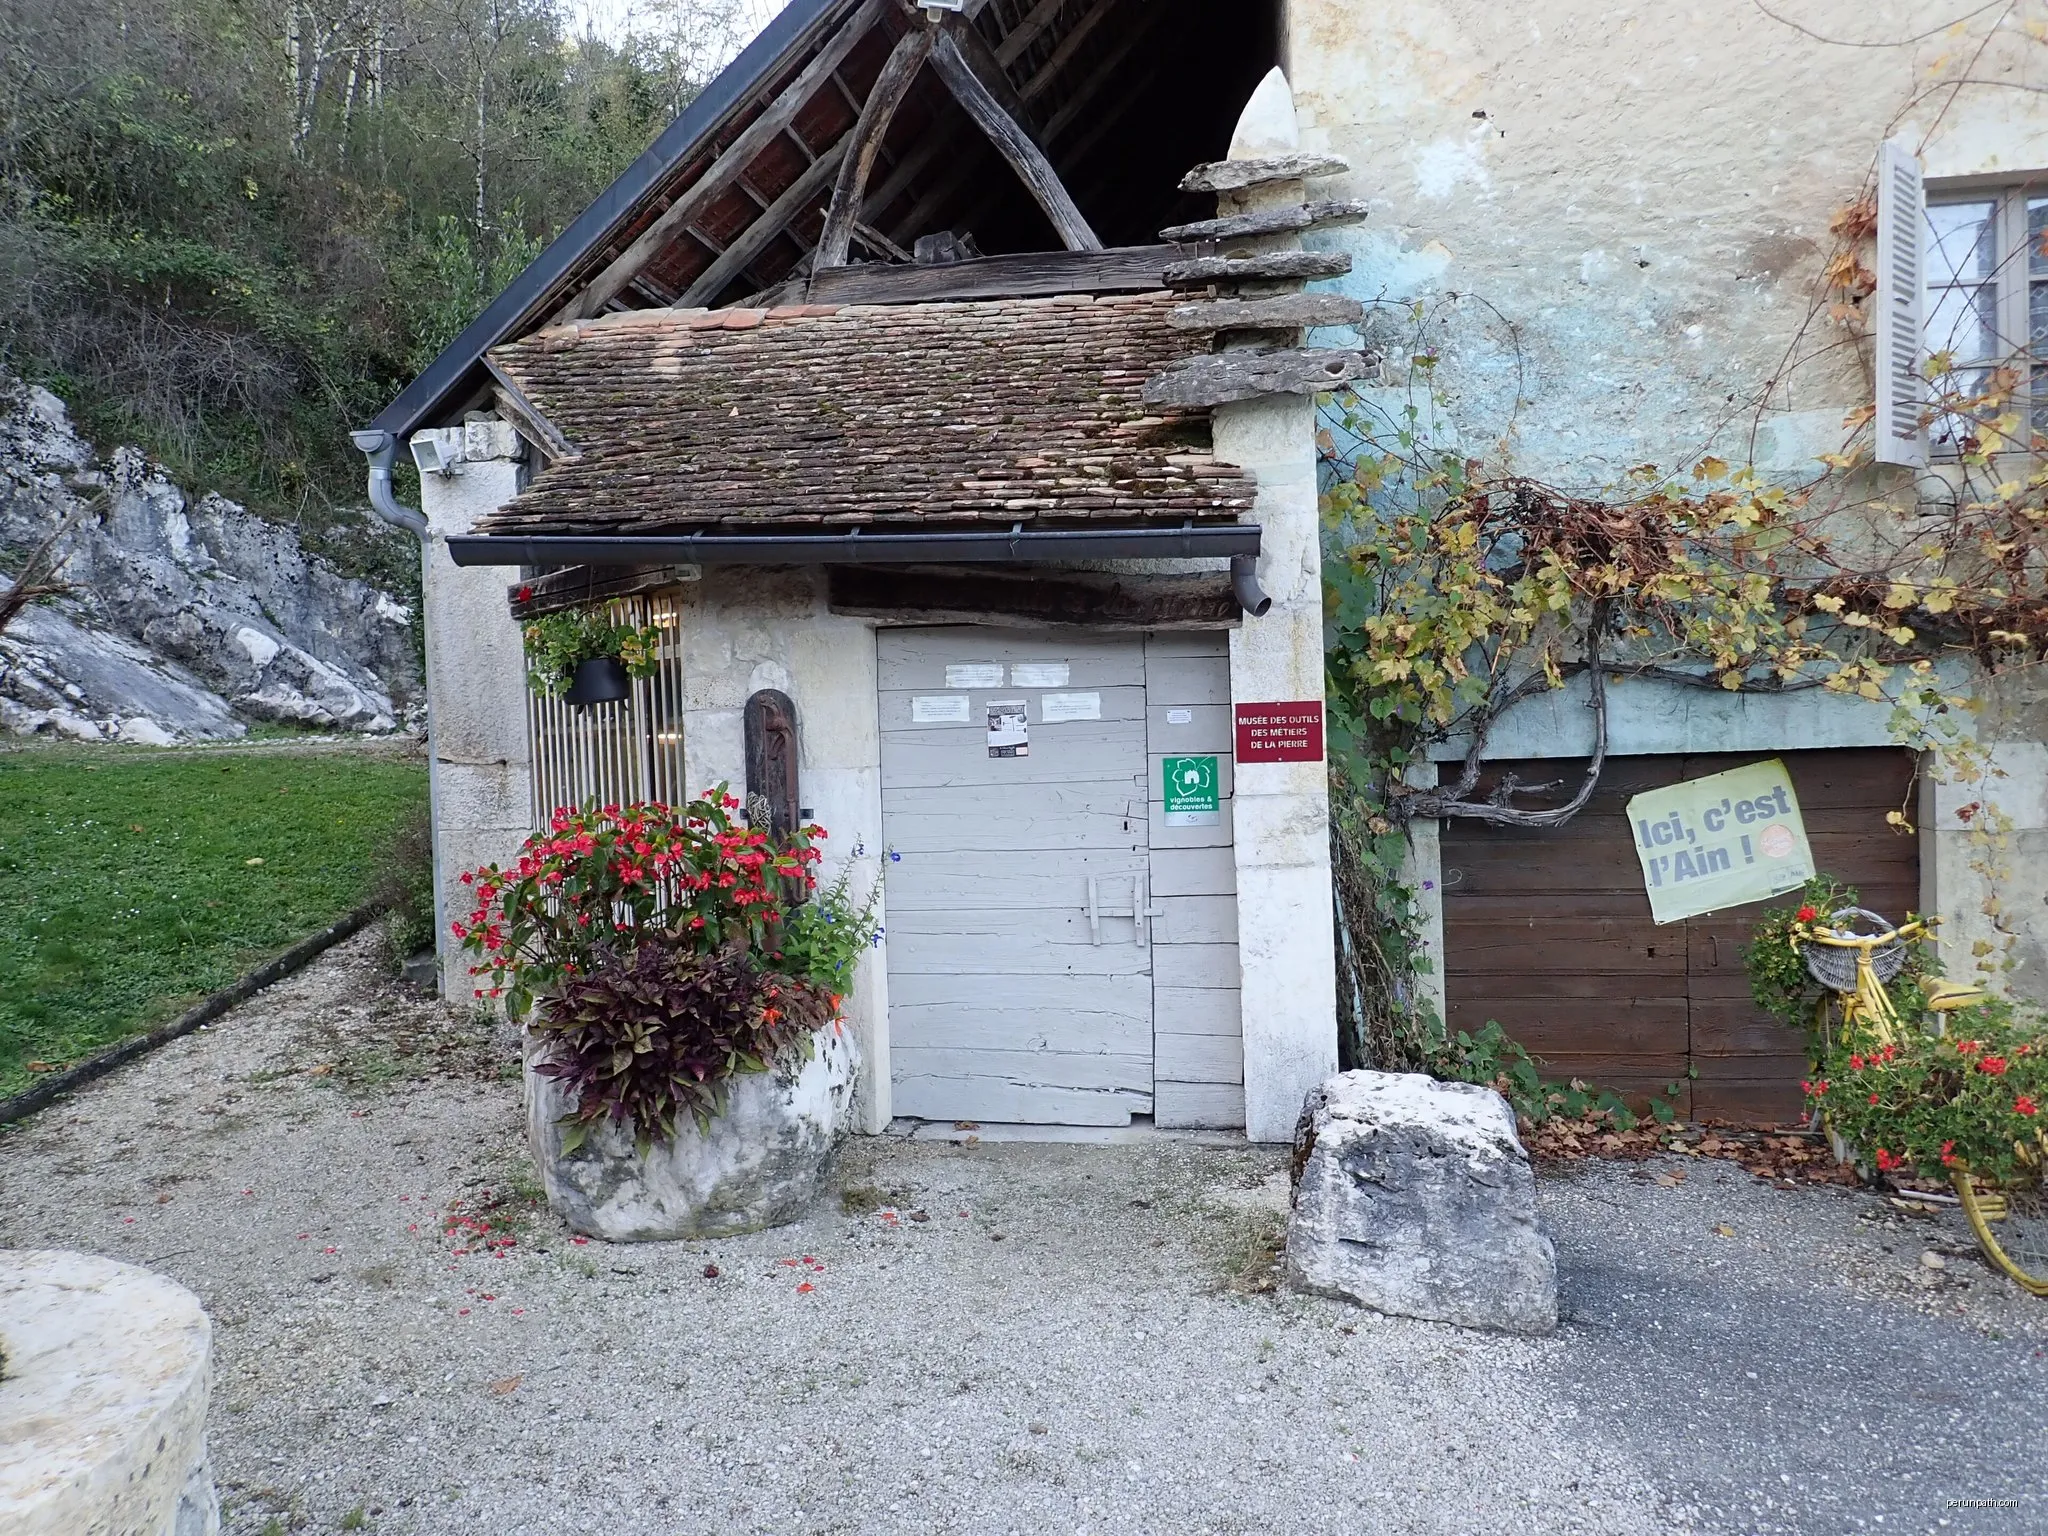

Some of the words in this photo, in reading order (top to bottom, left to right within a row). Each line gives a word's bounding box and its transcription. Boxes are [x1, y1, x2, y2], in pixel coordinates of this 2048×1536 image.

[1238, 715, 1268, 726] MUSÉE
[1270, 716, 1287, 725] DES
[1289, 715, 1320, 724] OUTILS
[1251, 728, 1268, 737] DES
[1270, 727, 1308, 737] MÉTIERS
[1251, 741, 1262, 749] DE
[1265, 740, 1276, 749] LA
[1278, 739, 1309, 749] PIERRE
[1169, 796, 1205, 805] vignobles
[1170, 803, 1213, 811] découvertes
[1637, 811, 1696, 849] Ici,
[1703, 785, 1791, 832] c'est
[1648, 845, 1732, 888] l'Ain
[1740, 834, 1755, 865] !
